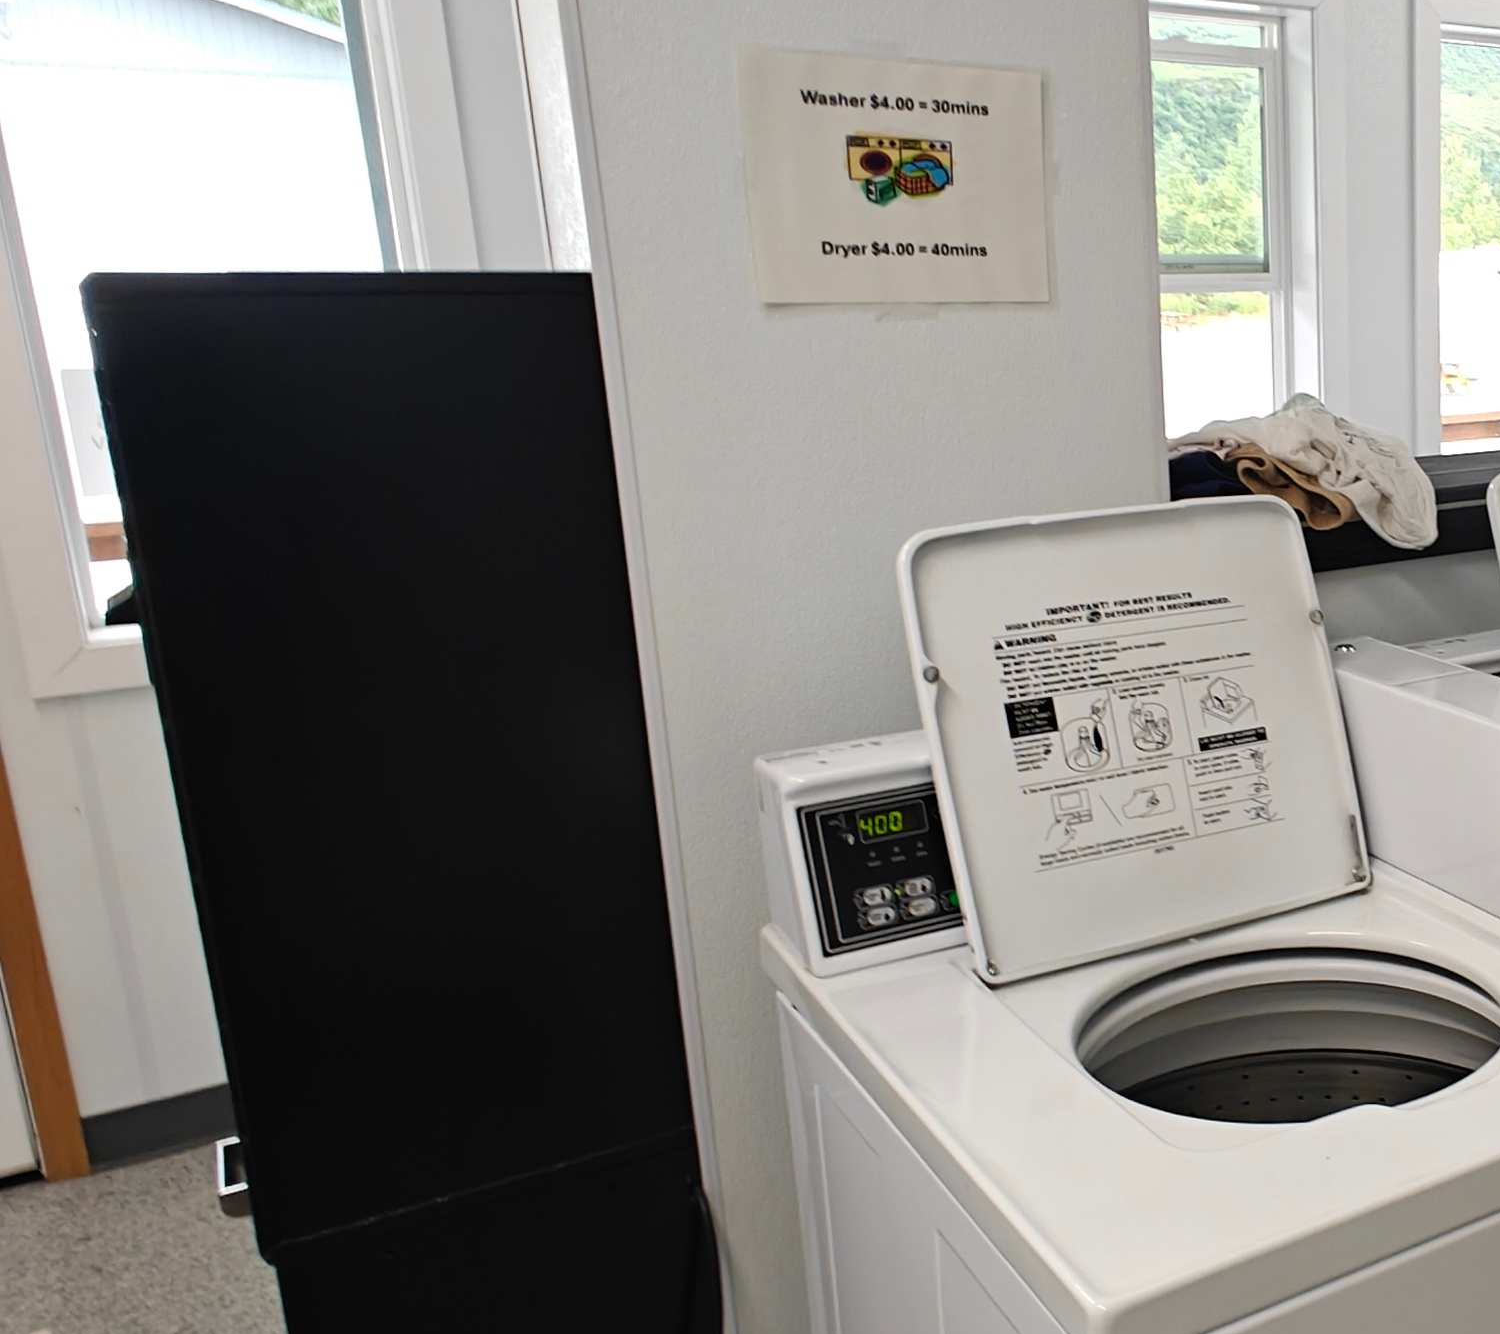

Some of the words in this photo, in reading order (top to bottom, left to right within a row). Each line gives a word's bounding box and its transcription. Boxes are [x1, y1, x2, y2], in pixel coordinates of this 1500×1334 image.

[800, 89, 866, 108] Washer
[870, 94, 915, 113] $4.00
[931, 100, 990, 117] 30mins
[821, 240, 868, 259] Dryer
[871, 241, 915, 257] $4.00
[931, 242, 989, 258] 40mins
[1004, 633, 1057, 647] WARNING
